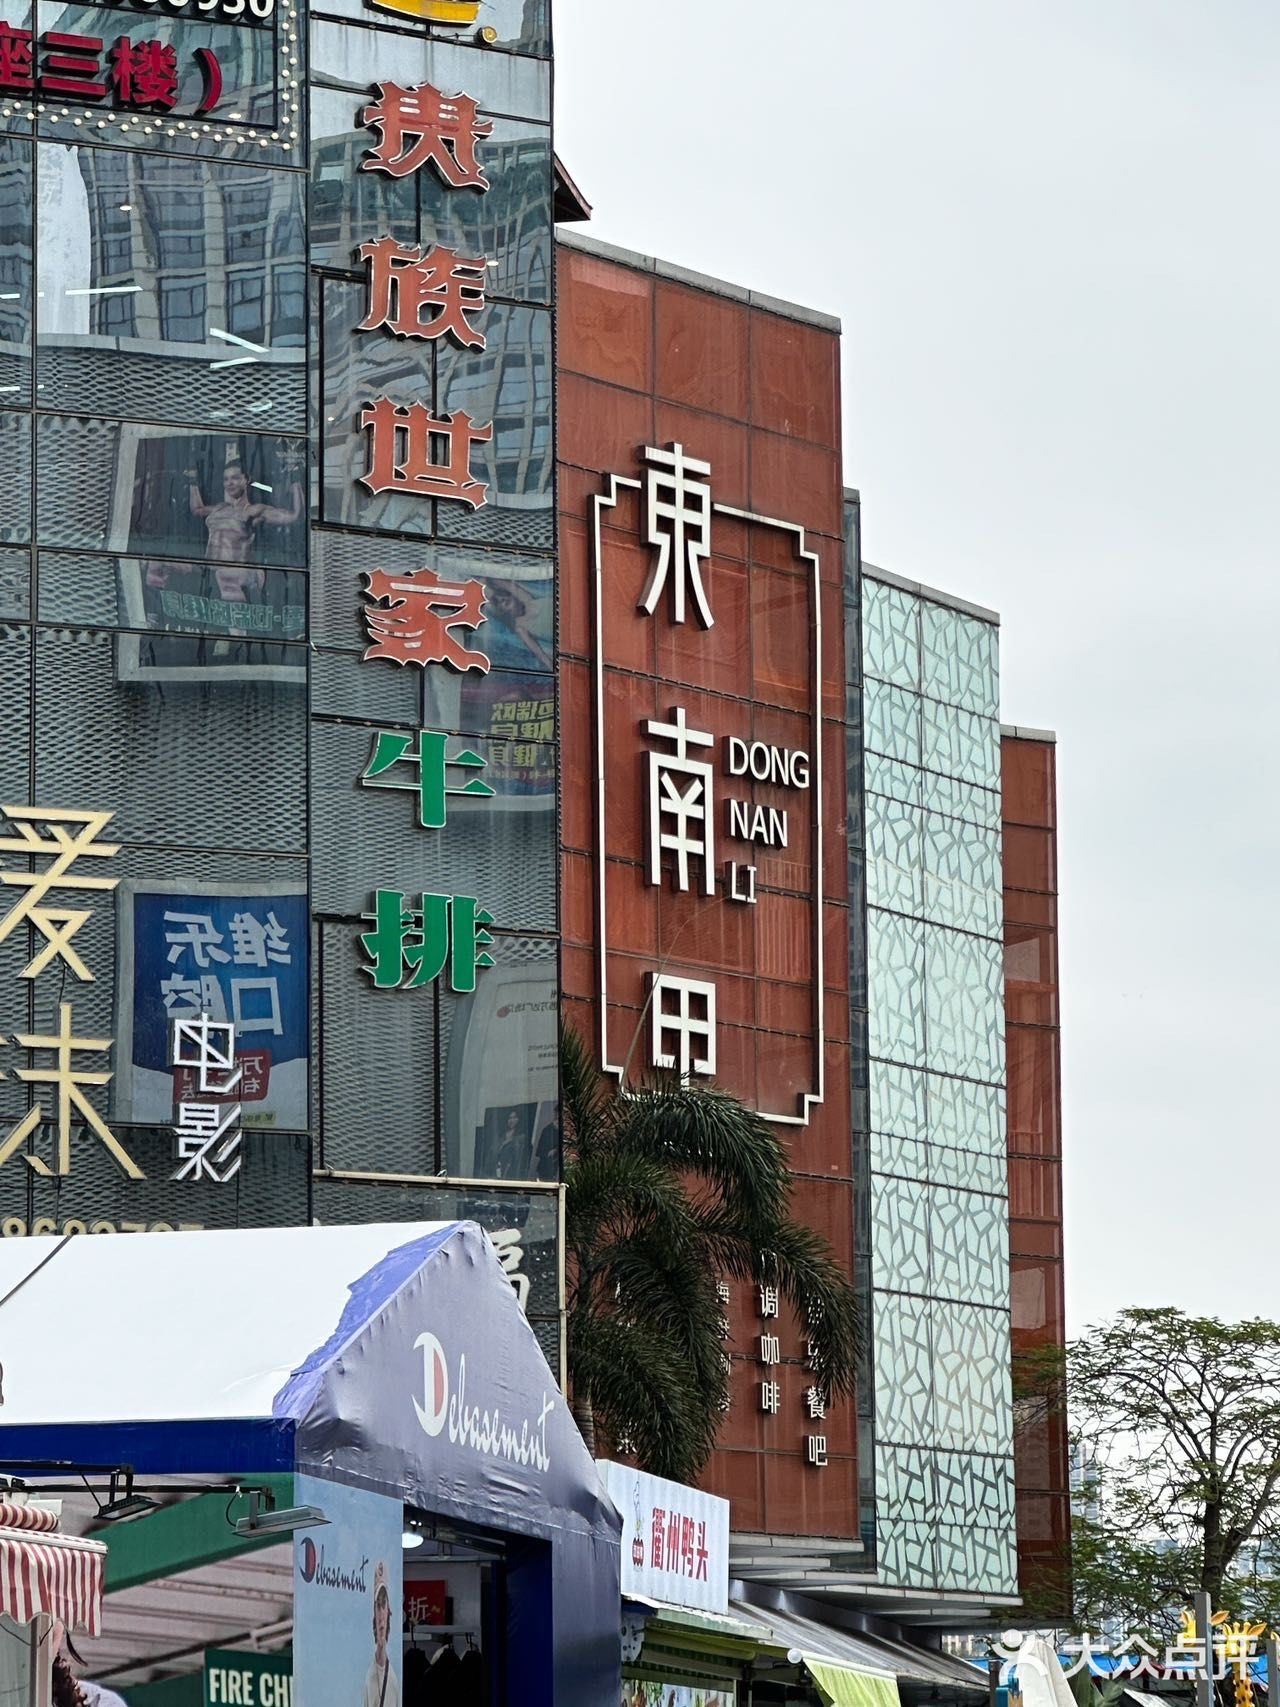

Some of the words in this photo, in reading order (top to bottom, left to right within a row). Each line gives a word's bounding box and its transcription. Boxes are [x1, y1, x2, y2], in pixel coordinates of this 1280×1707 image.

[729, 736, 809, 789] DONG
[730, 799, 788, 847] NAN
[731, 861, 757, 903] LI
[173, 1012, 242, 1182] 电影
[759, 1248, 781, 1414] 调咖啡
[411, 1332, 555, 1472] Debasement
[209, 1668, 255, 1706] FIRE
